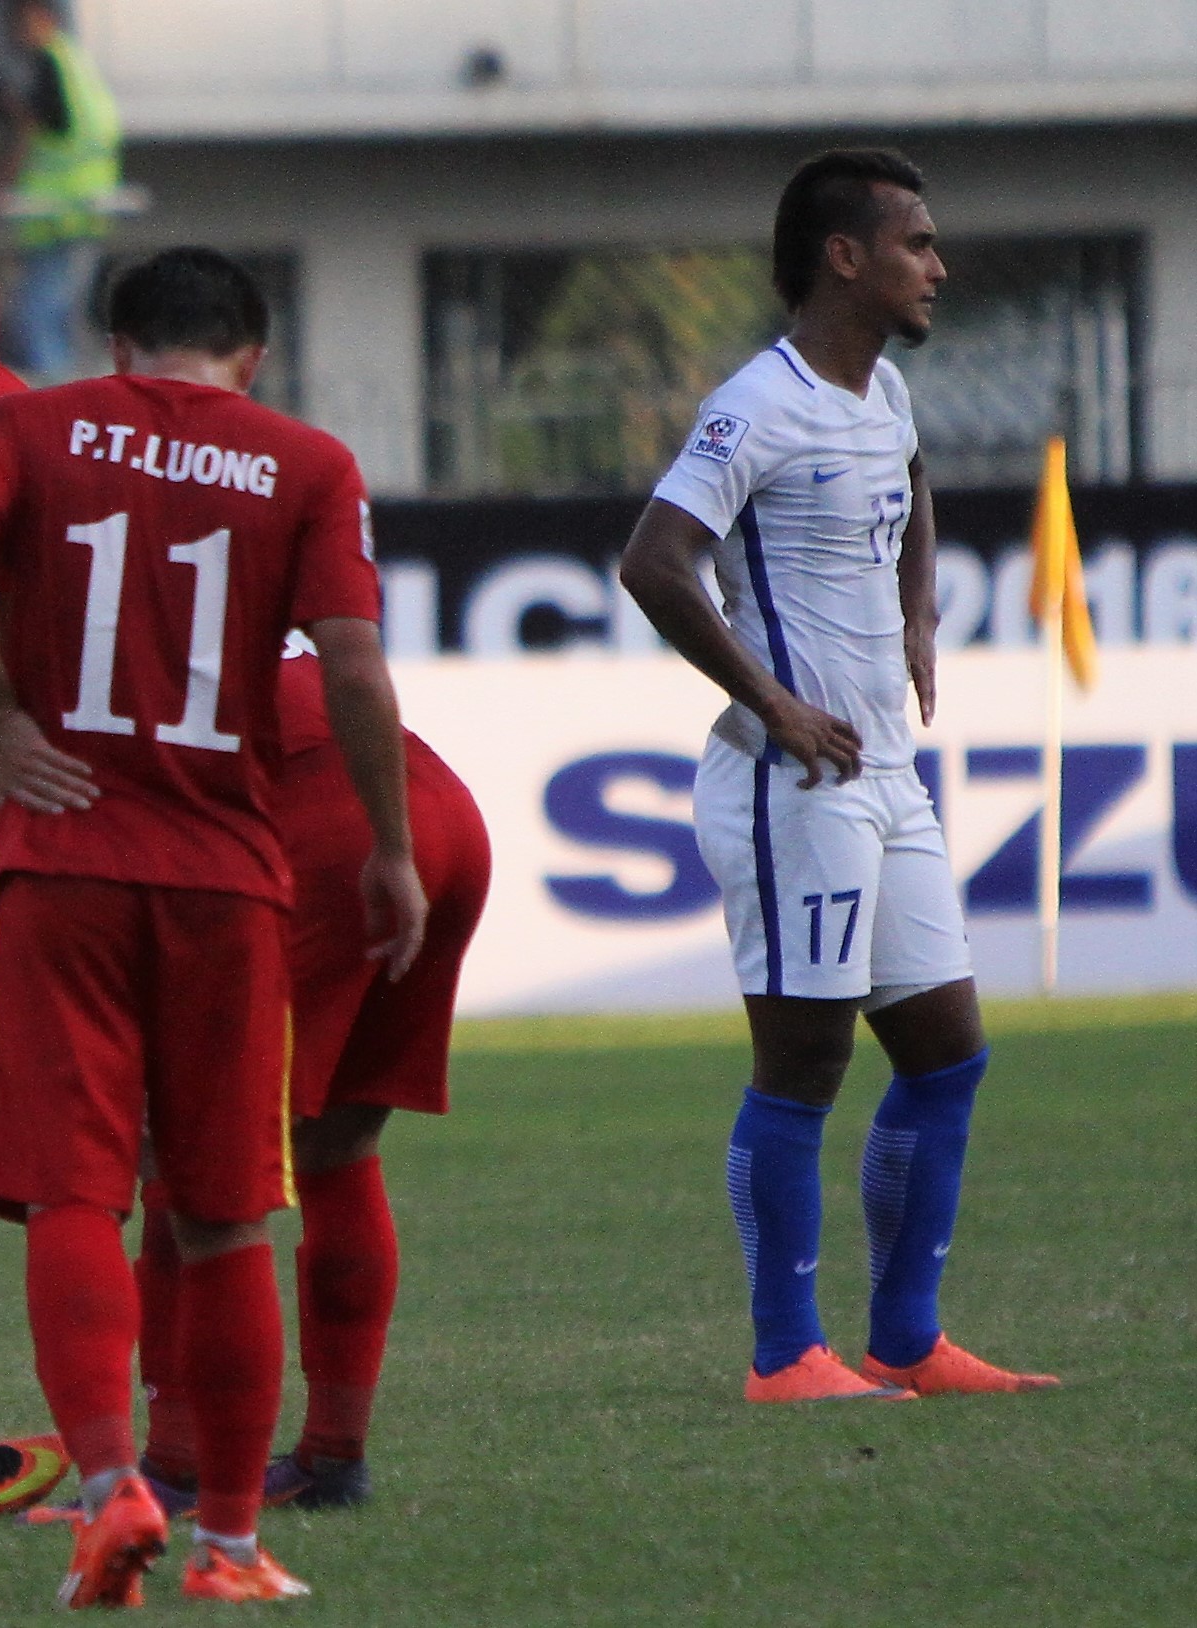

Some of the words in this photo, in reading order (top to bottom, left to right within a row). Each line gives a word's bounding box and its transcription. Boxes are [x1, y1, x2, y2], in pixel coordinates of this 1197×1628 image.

[69, 418, 279, 498] P.T.LUONG
[62, 512, 241, 753] 11
[803, 889, 863, 964] 17
